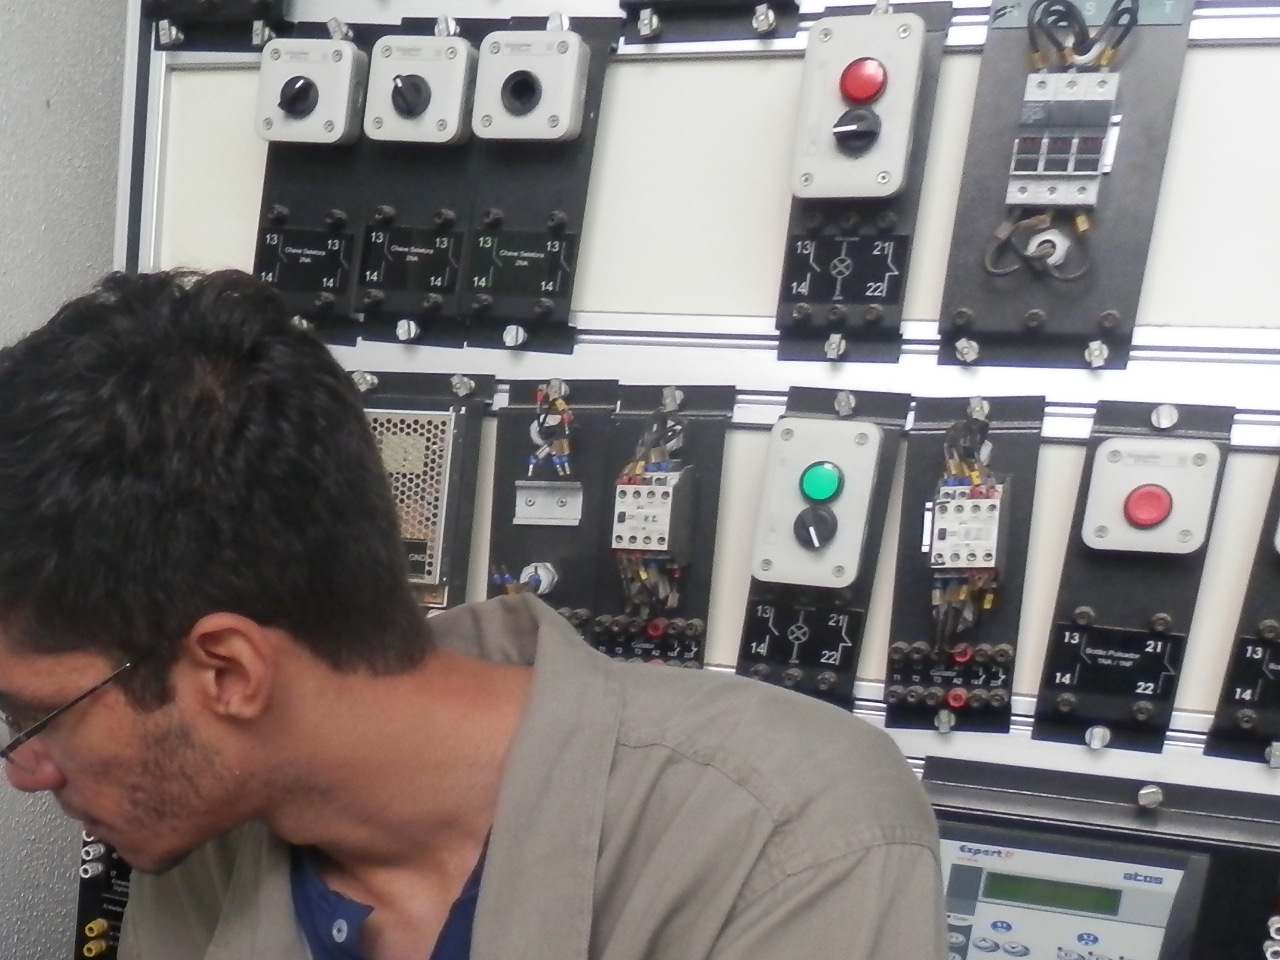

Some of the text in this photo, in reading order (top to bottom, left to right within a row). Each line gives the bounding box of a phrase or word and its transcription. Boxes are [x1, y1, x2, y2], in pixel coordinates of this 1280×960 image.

[265, 233, 278, 245] 13
[370, 231, 384, 243] 13
[435, 237, 448, 249] 13
[478, 236, 492, 248] 13
[327, 239, 339, 250] 13
[546, 240, 559, 252] 13
[796, 240, 811, 254] 13
[872, 241, 889, 255] 21
[260, 271, 273, 282] 14
[322, 277, 334, 288] 14
[365, 270, 378, 282] 14
[430, 276, 442, 287] 14
[473, 276, 486, 288] 14
[540, 280, 553, 291] 14
[791, 282, 807, 296] 14
[865, 282, 883, 296] 22
[757, 605, 771, 618] 13
[828, 613, 844, 626] 21
[1064, 631, 1080, 644] 13
[750, 641, 766, 656] 14
[1144, 640, 1163, 653] 21
[1246, 645, 1263, 659] 13
[820, 650, 837, 664] 22
[1055, 672, 1071, 684] 14
[1135, 681, 1155, 695] 22
[1234, 687, 1252, 701] 14
[959, 844, 1002, 858] Expert
